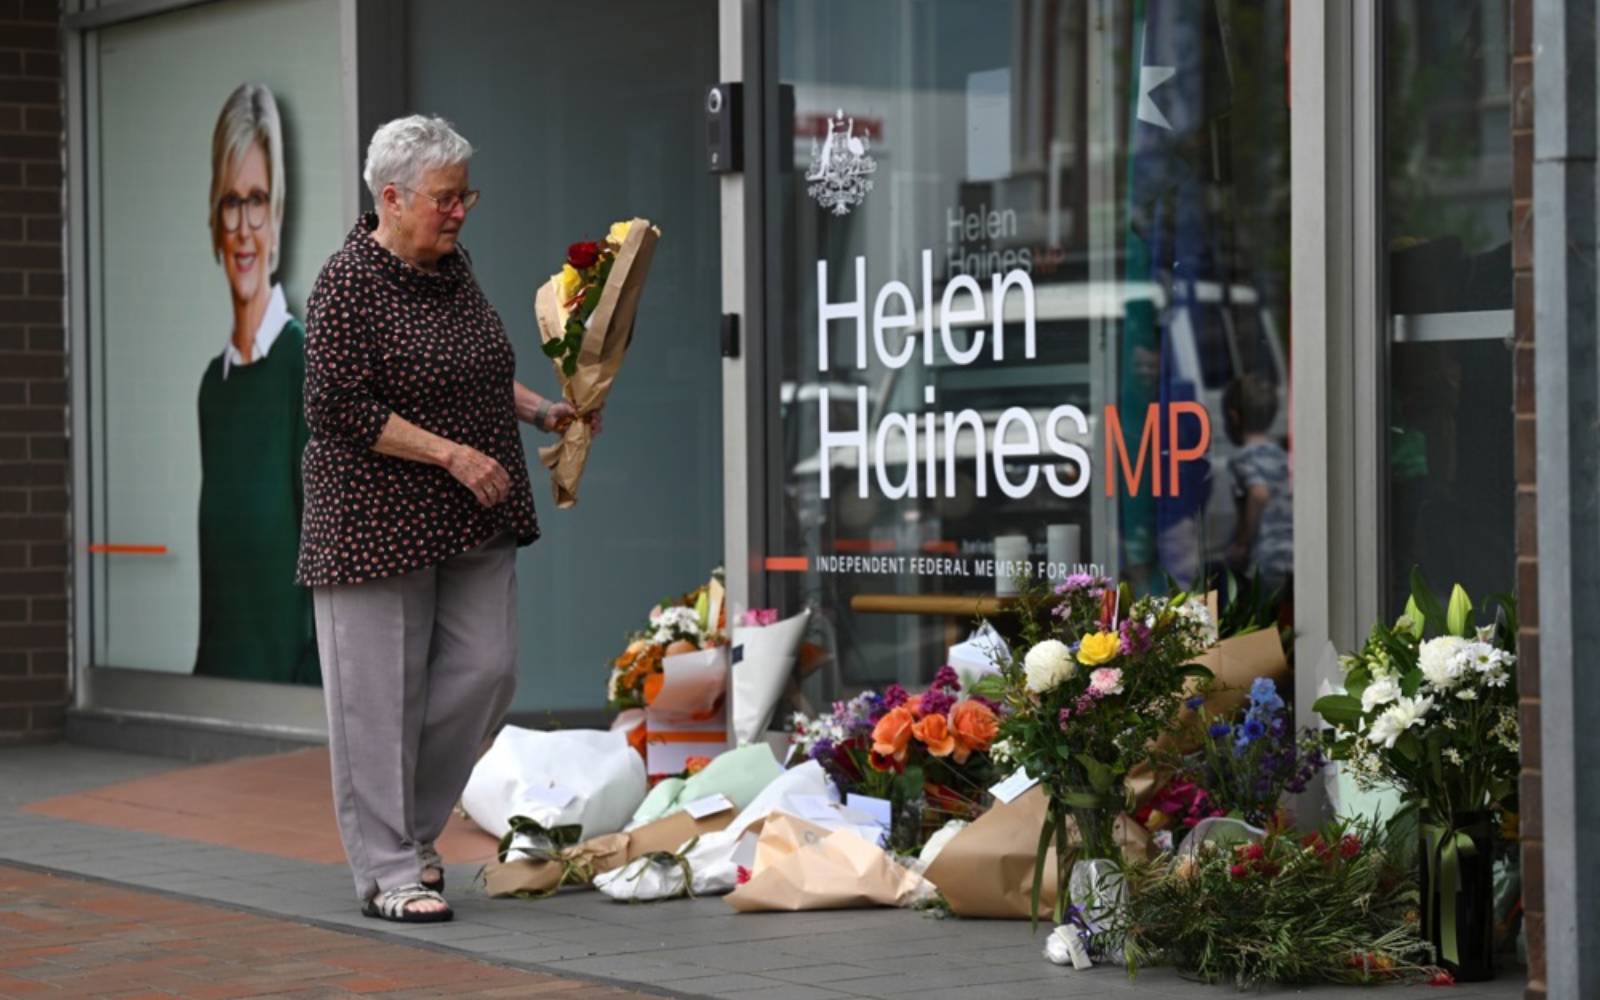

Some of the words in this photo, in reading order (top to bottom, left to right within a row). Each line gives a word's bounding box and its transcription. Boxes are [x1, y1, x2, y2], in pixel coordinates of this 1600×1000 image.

[946, 203, 1017, 243] Helen
[947, 245, 1032, 279] Haines
[817, 249, 1036, 372] Helen
[819, 385, 1092, 499] Haines
[1104, 401, 1212, 497] MP
[815, 556, 905, 574] INDEPENDENT
[909, 557, 970, 577] FEDERAL
[1037, 562, 1067, 580] FOR
